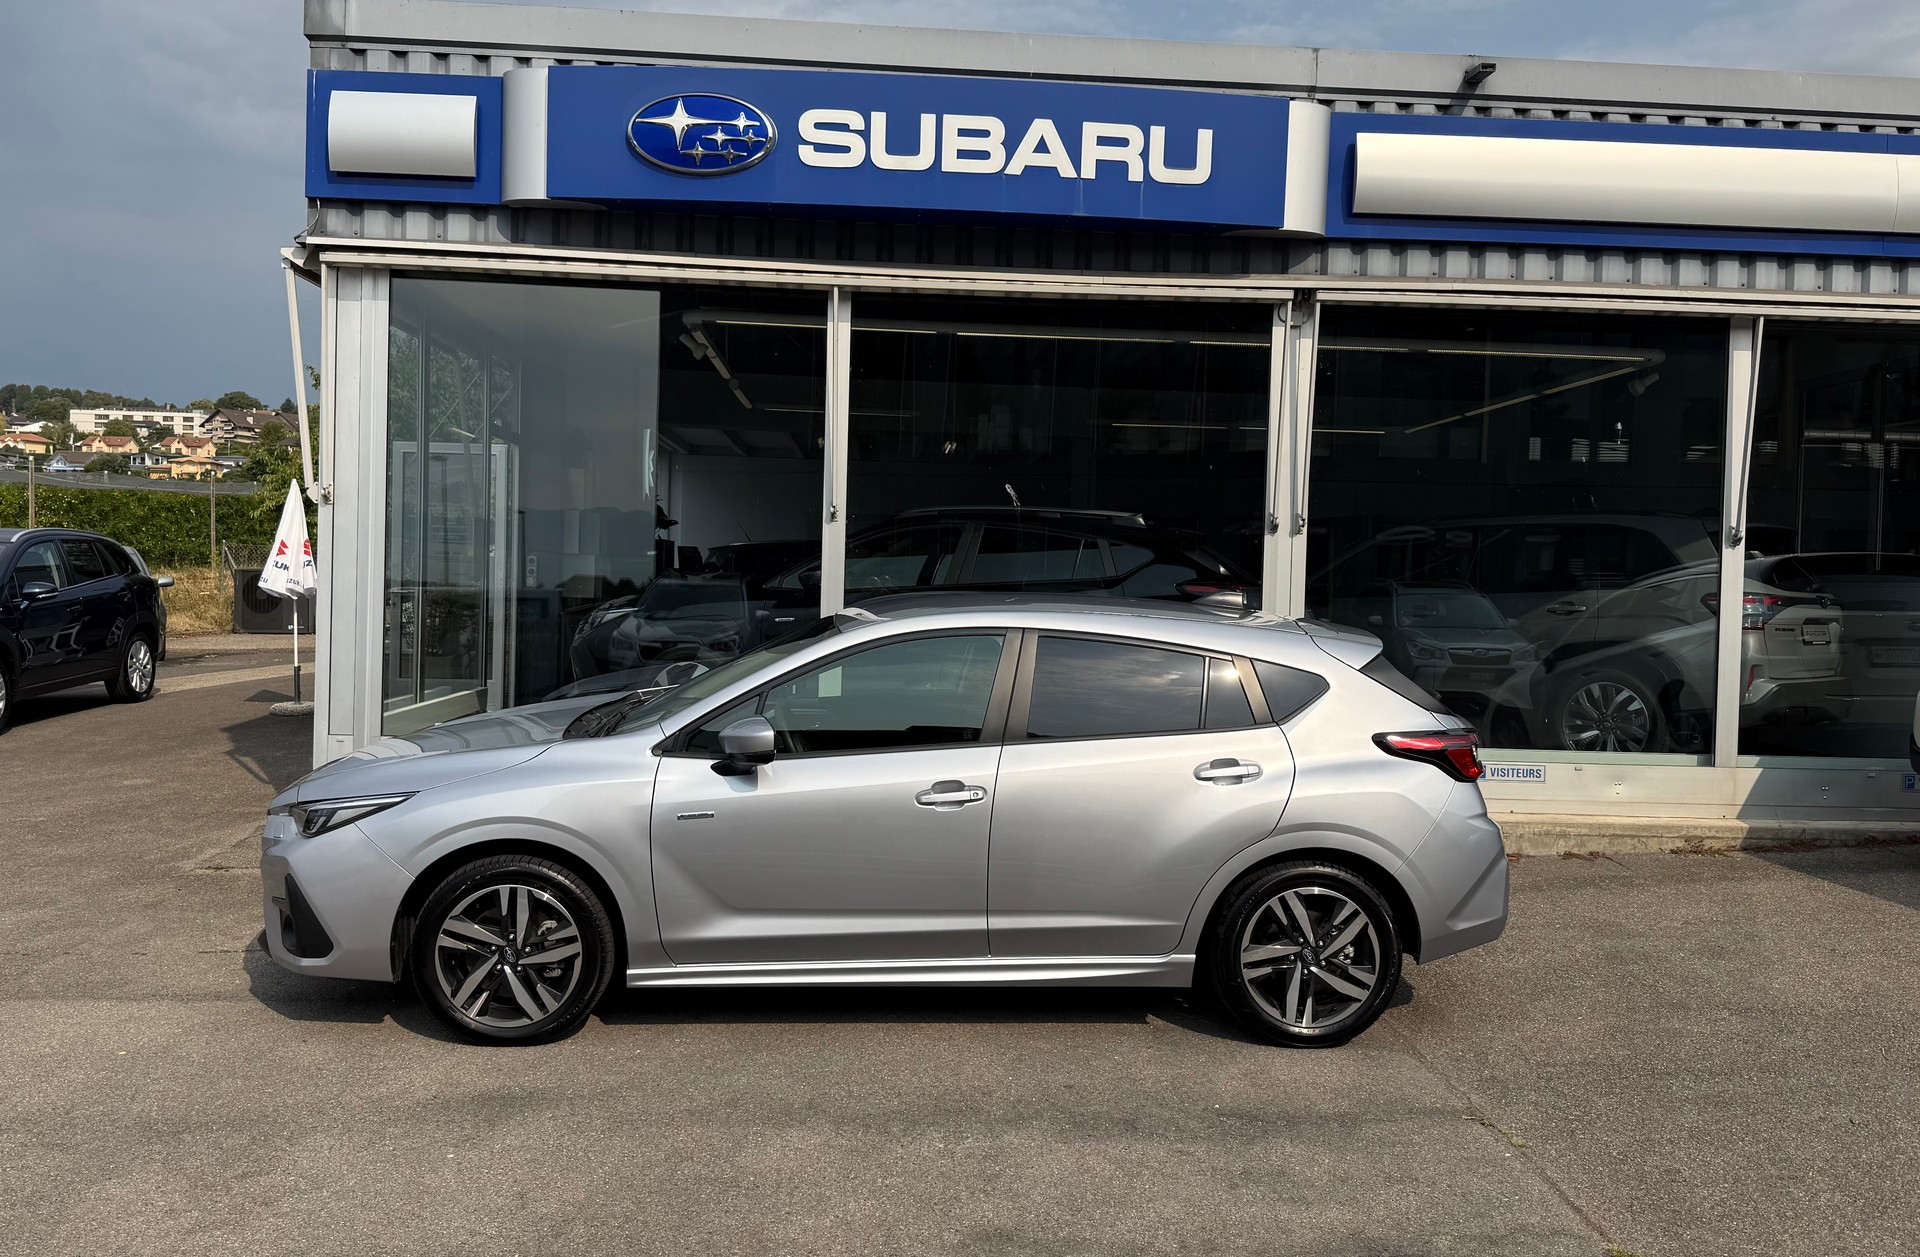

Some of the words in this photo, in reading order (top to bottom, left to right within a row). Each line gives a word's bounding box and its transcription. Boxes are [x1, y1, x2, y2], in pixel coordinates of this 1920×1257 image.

[797, 109, 1214, 186] SUBARU
[1490, 767, 1542, 779] VISITEURS
[1906, 776, 1915, 788] P
